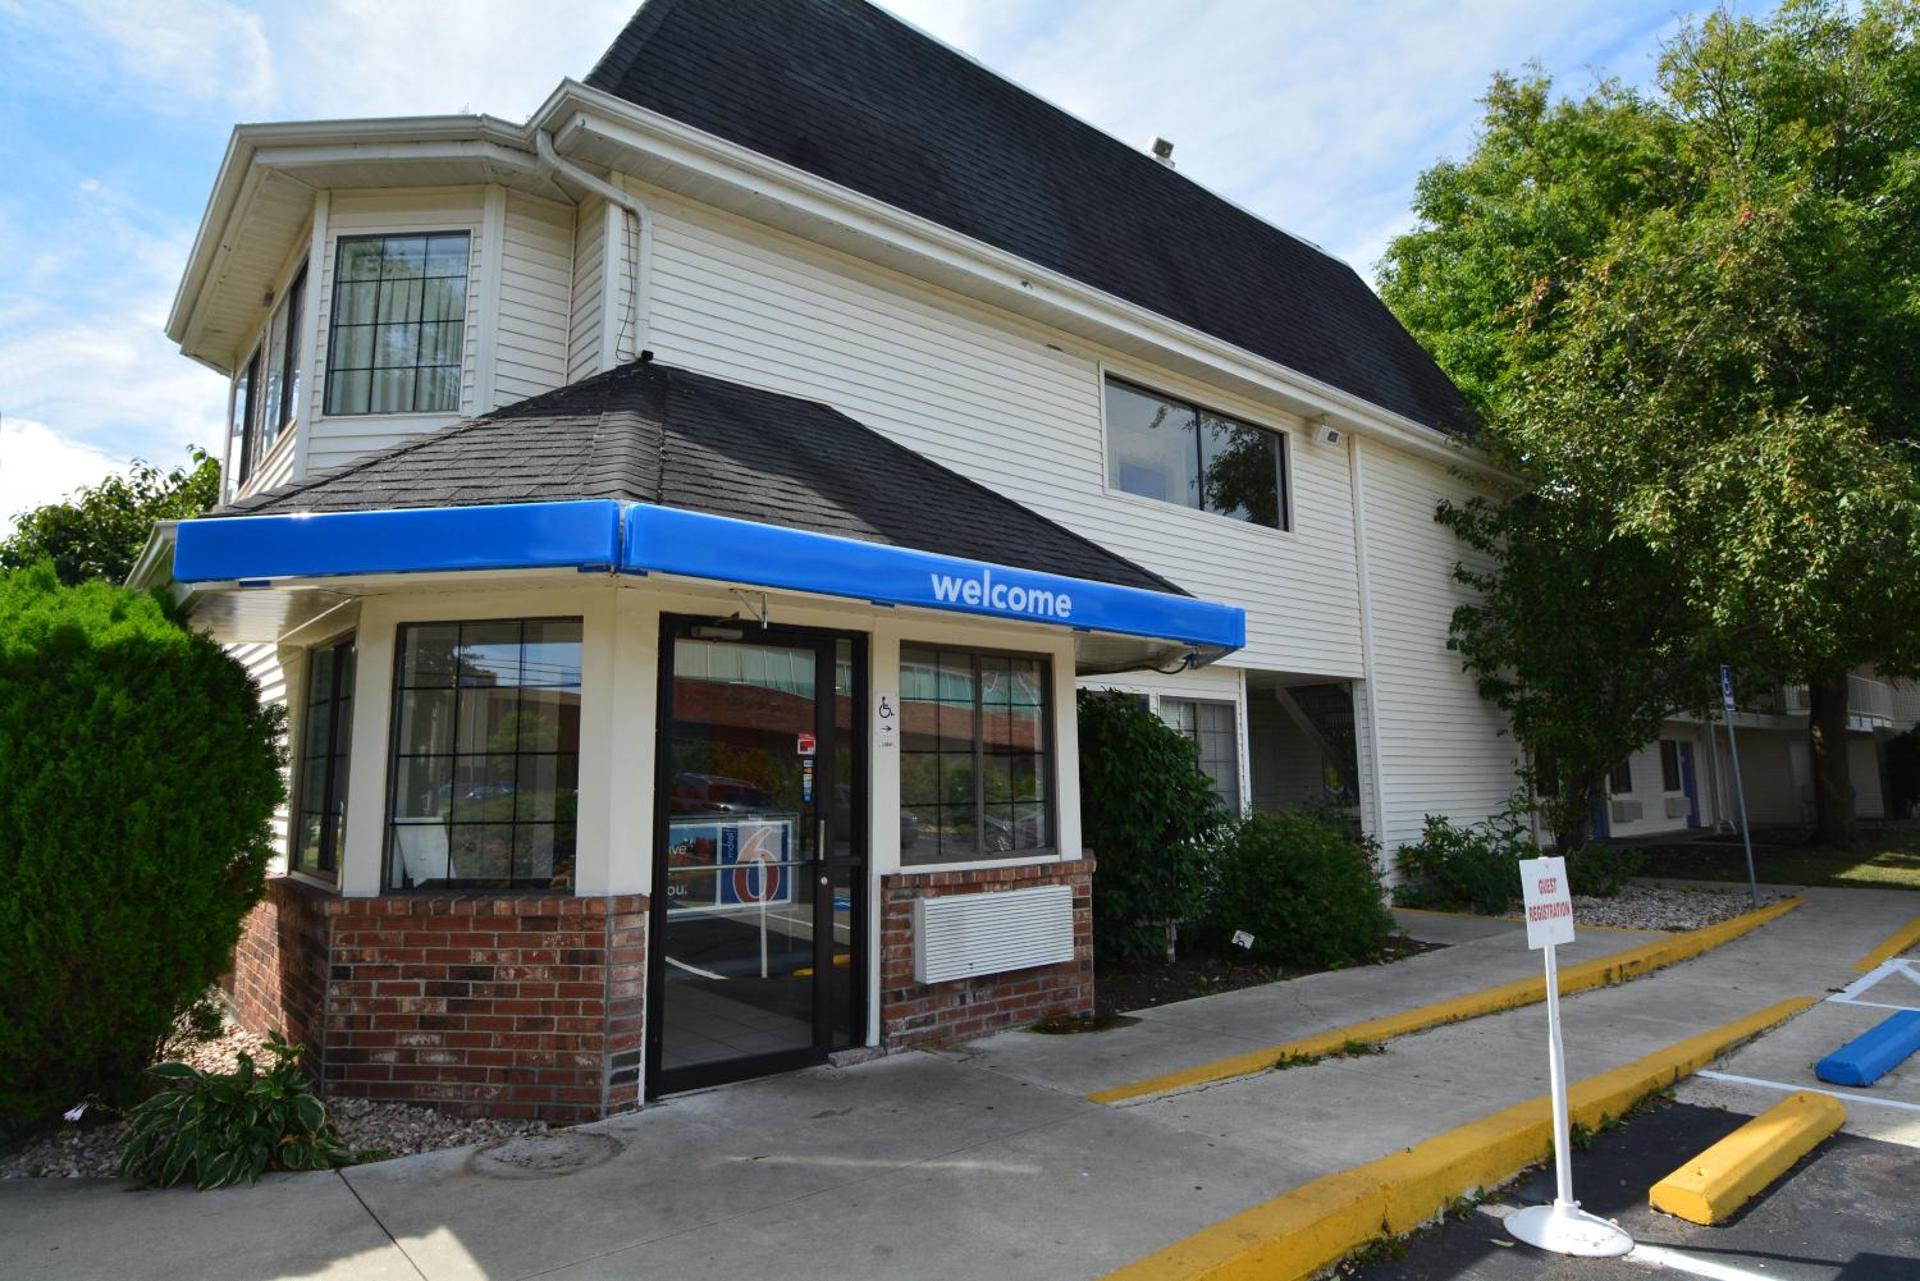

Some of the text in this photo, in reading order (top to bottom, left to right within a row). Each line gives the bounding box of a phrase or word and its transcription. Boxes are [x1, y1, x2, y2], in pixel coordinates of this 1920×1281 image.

[930, 568, 1072, 618] welcome
[732, 826, 781, 904] 6
[1538, 877, 1557, 895] GUEST
[1528, 901, 1570, 922] REGISTRATION
